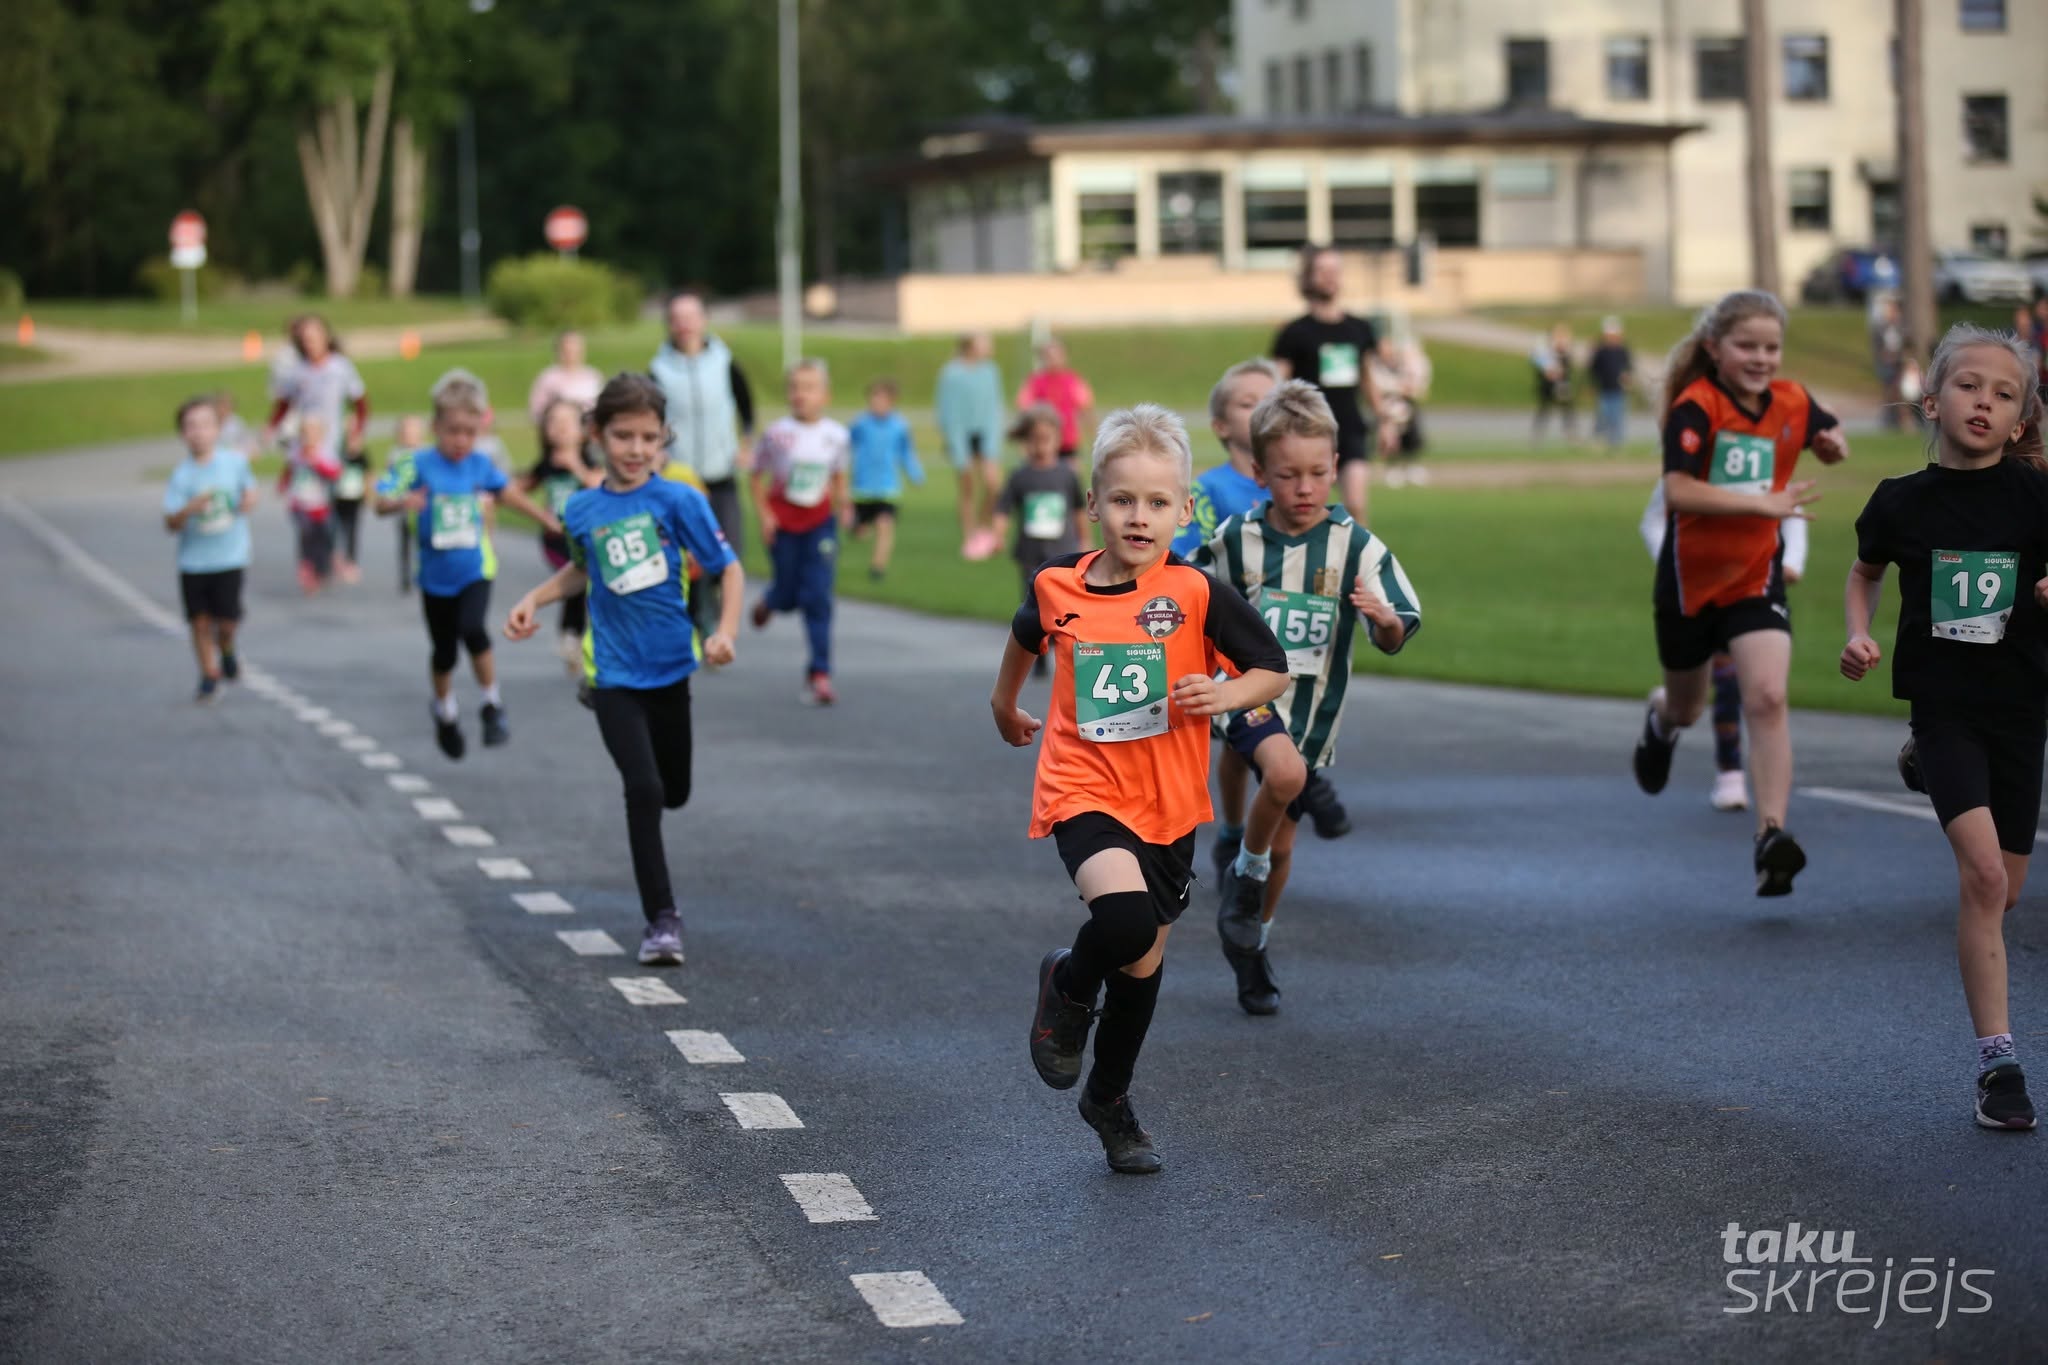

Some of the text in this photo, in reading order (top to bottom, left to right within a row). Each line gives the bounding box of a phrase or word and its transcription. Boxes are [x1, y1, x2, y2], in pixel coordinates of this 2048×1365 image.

[1724, 446, 1761, 479] 81
[605, 528, 648, 568] 85
[1951, 571, 2001, 608] 19
[1264, 606, 1331, 645] 155
[1126, 648, 1162, 656] SIGULDAS
[1092, 663, 1149, 704] 43
